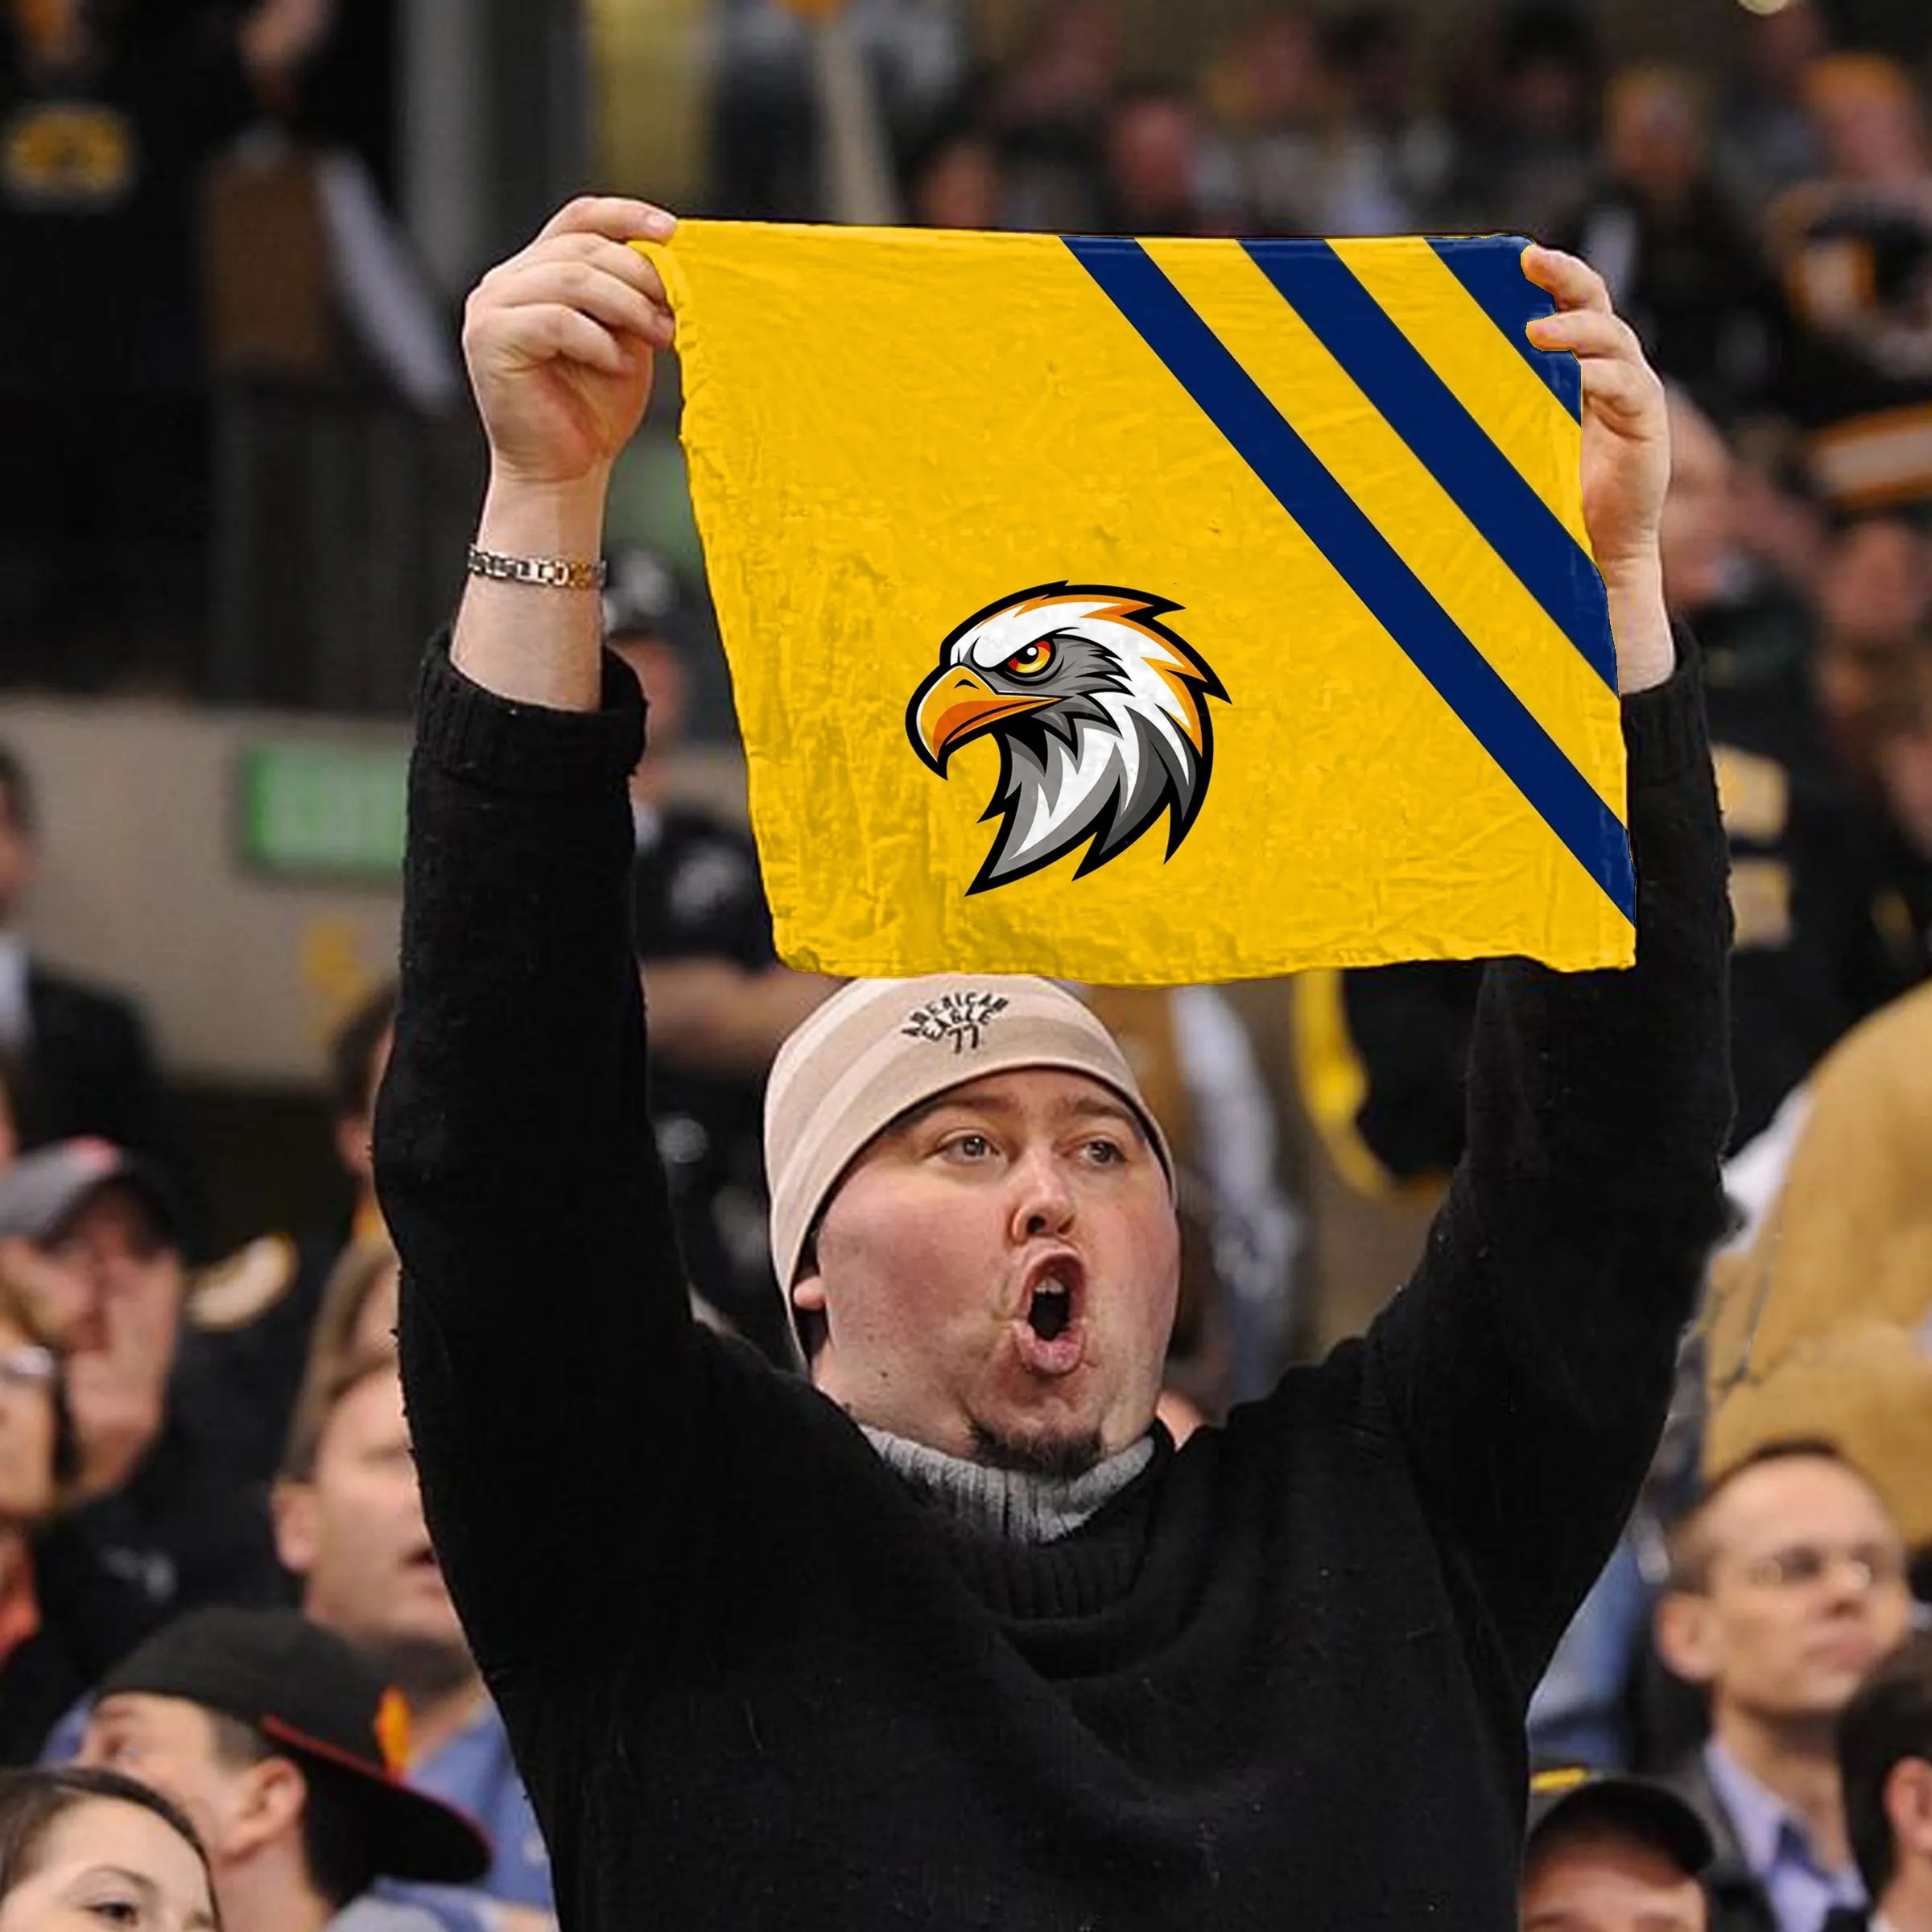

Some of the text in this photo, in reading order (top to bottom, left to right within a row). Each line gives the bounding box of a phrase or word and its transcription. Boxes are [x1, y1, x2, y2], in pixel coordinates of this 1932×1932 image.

[902, 992, 1009, 1037] AMERICAN
[923, 1008, 993, 1041] EAGLE
[948, 1024, 979, 1054] 77
